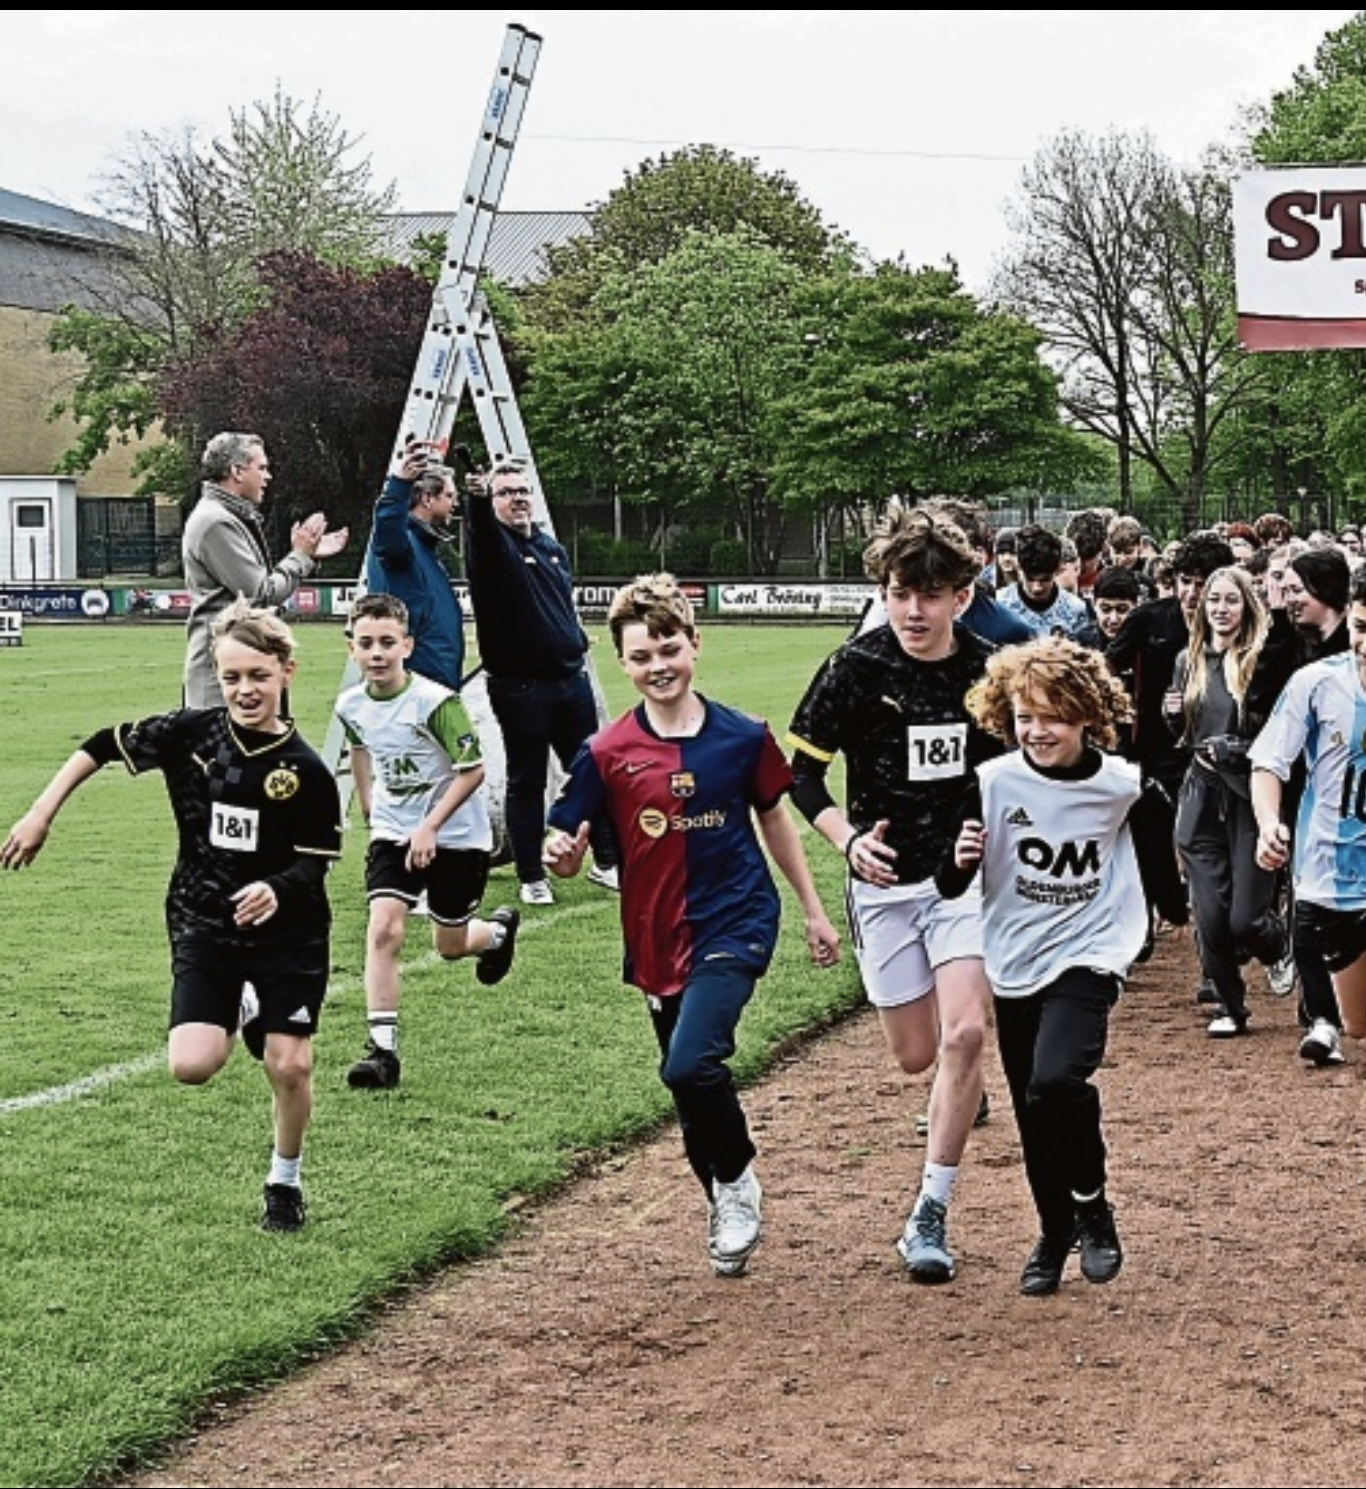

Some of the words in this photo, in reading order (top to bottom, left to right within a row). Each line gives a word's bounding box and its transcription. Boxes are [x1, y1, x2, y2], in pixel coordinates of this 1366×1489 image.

[914, 736, 962, 767] 1&1
[215, 812, 252, 840] 1&1
[671, 810, 725, 832] Spotify
[1017, 837, 1101, 878] OM
